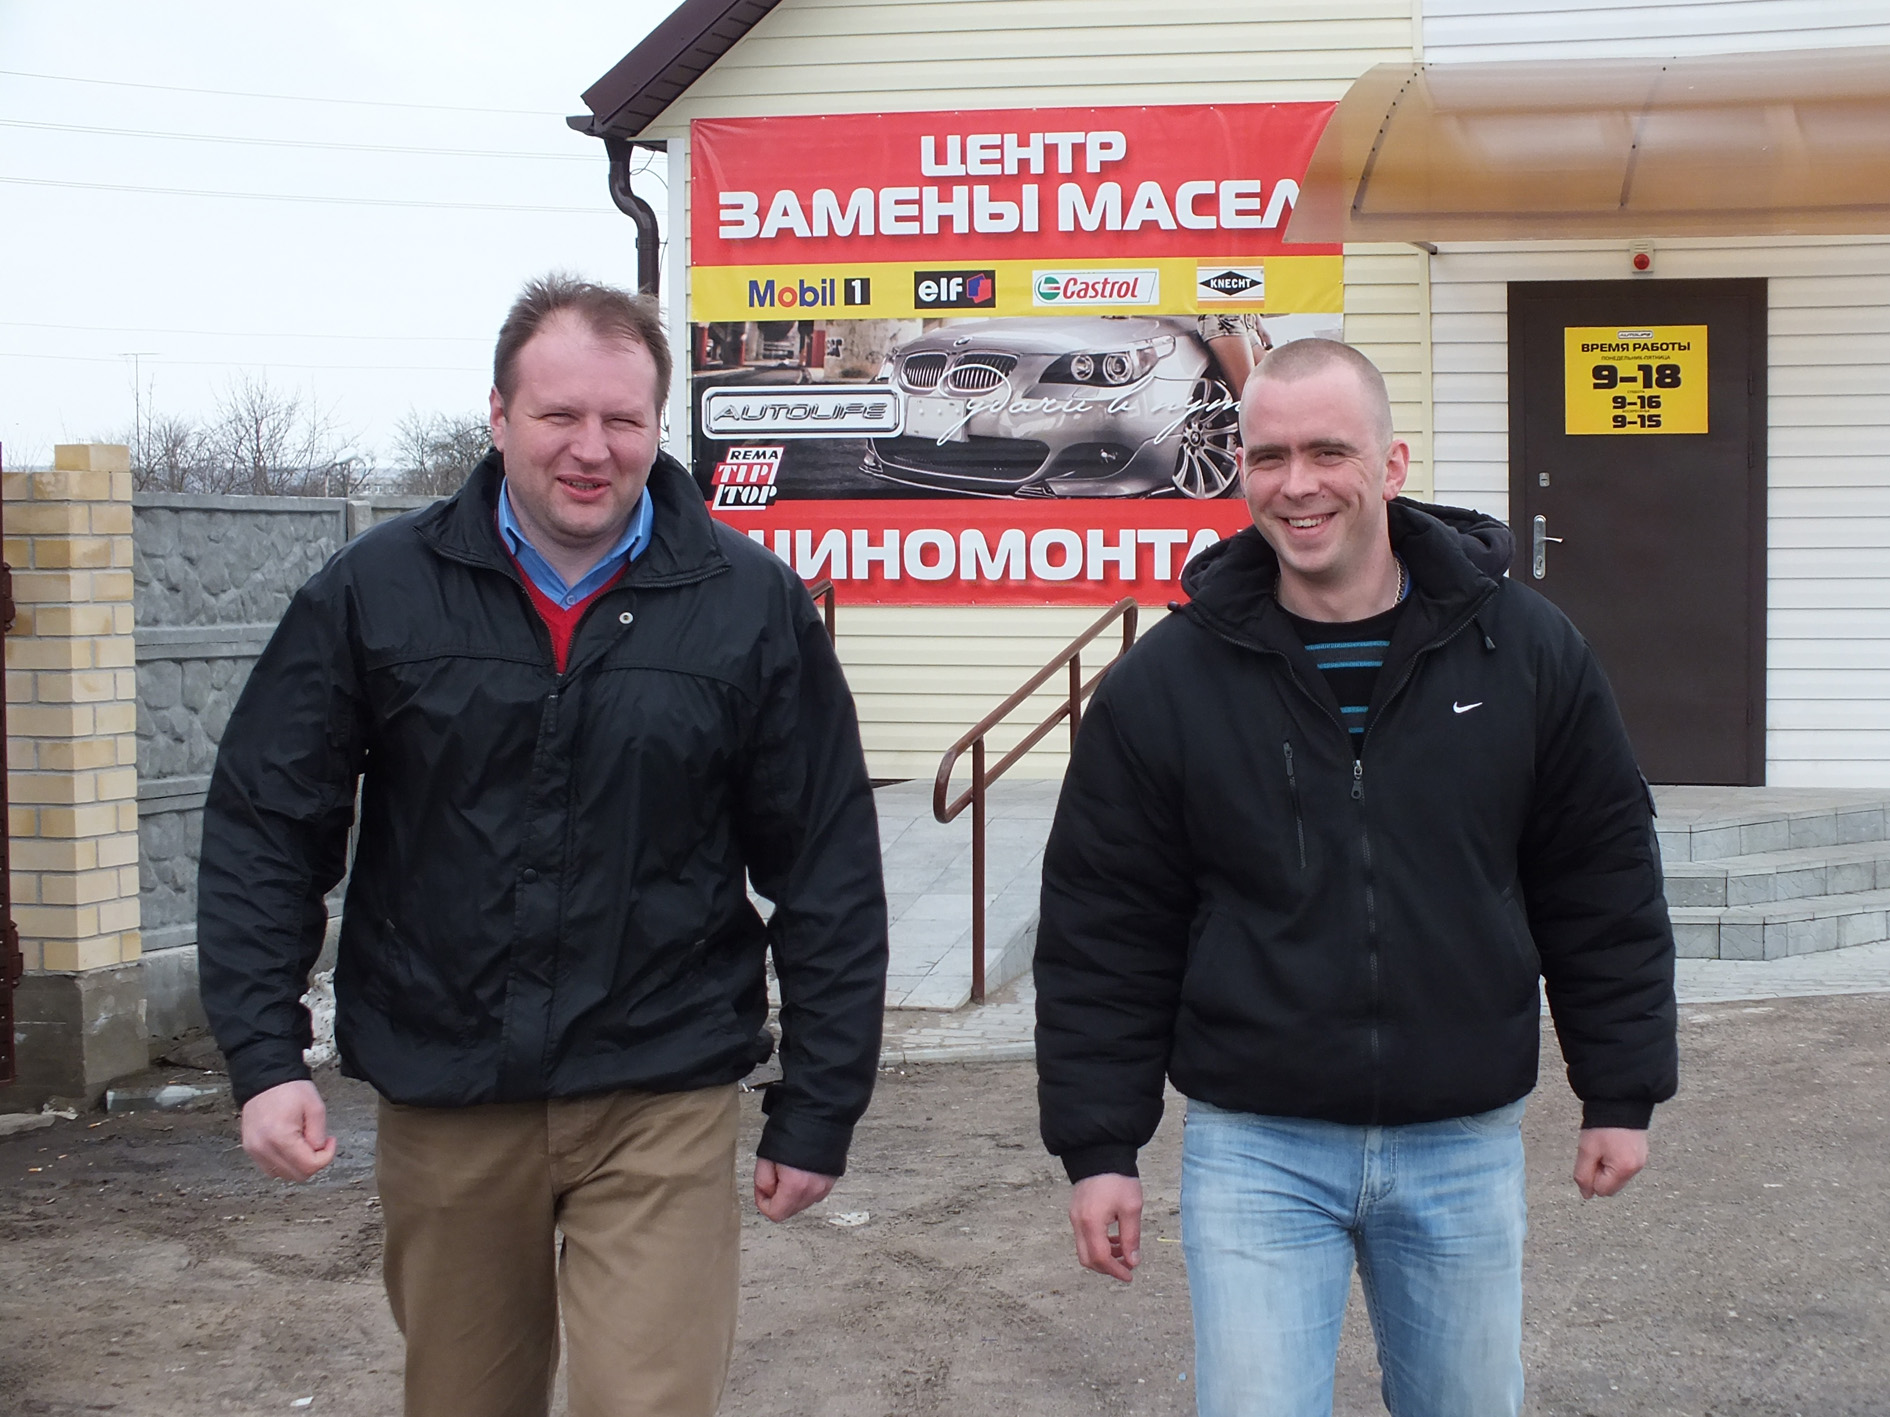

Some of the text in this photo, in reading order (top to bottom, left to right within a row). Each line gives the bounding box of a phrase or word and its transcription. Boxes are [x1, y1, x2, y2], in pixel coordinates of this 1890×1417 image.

[921, 131, 1126, 177] ЦЕНТР
[719, 178, 1300, 239] ЗАМЕНЫ МАСЕЛ
[918, 277, 963, 302] elf
[1062, 277, 1139, 300] Castrol
[1210, 278, 1252, 289] KNECHT
[749, 279, 862, 308] Mobil 1
[1581, 341, 1691, 353] ВРЕМЯ РАБОТЫ
[714, 403, 888, 421] AUTOLIFE
[730, 450, 779, 460] REMA
[718, 464, 769, 483] TIP
[723, 485, 778, 504] TOP
